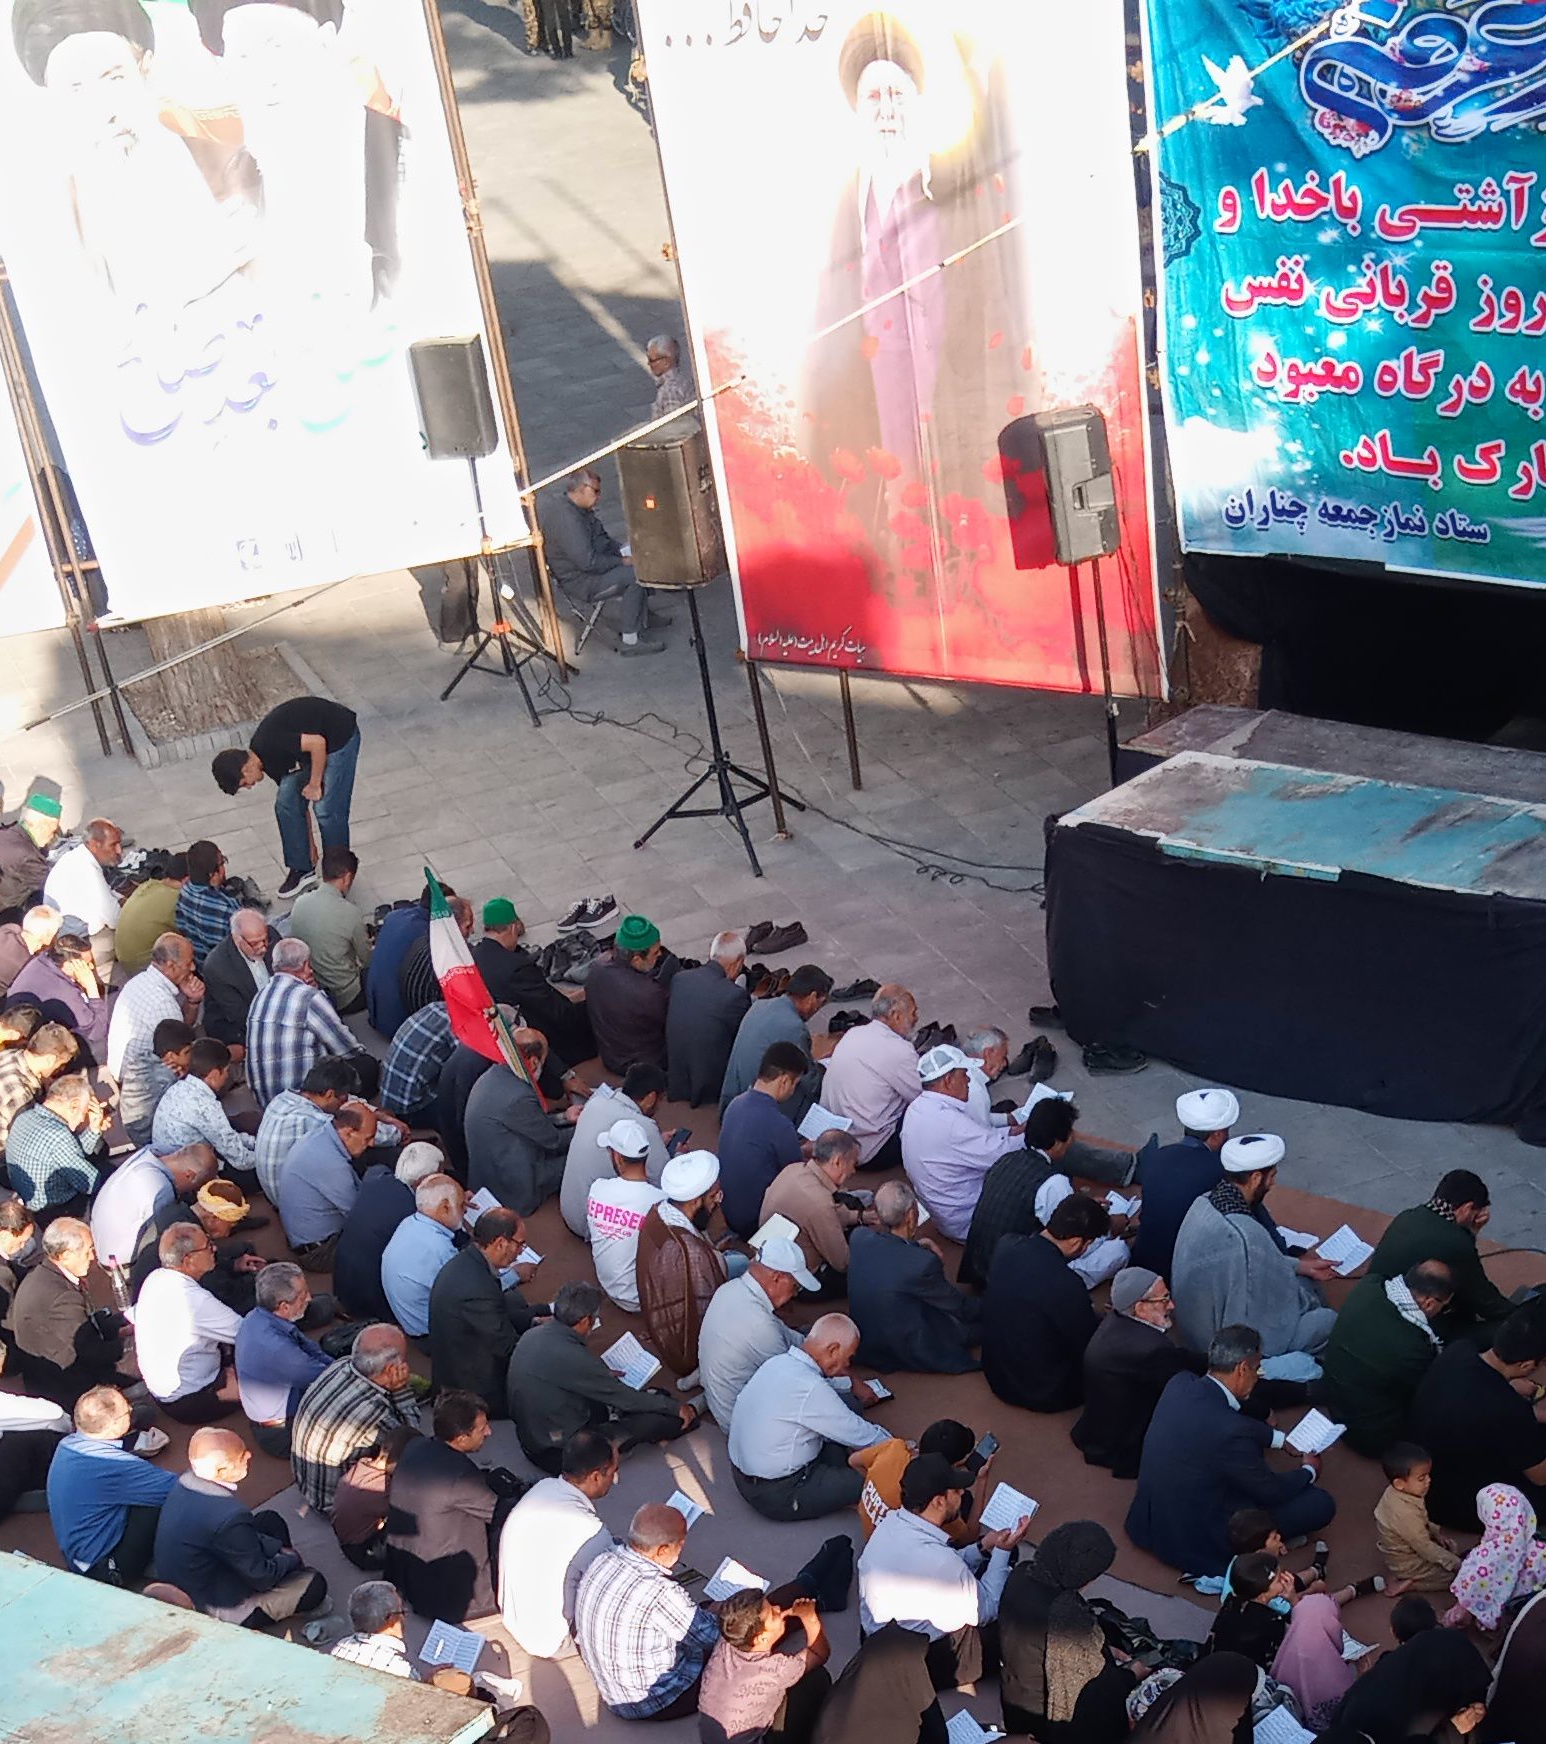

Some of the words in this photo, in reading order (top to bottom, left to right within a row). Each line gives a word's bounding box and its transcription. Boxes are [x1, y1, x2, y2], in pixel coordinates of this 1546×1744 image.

[1214, 188, 1241, 230] و
[1222, 256, 1306, 316] نفس
[1322, 261, 1456, 331] قربانی
[1253, 342, 1361, 402] معبود
[1375, 349, 1491, 416] درگاه
[1506, 369, 1545, 420] به
[1222, 489, 1308, 528] چناران
[1432, 503, 1489, 544] ستاد
